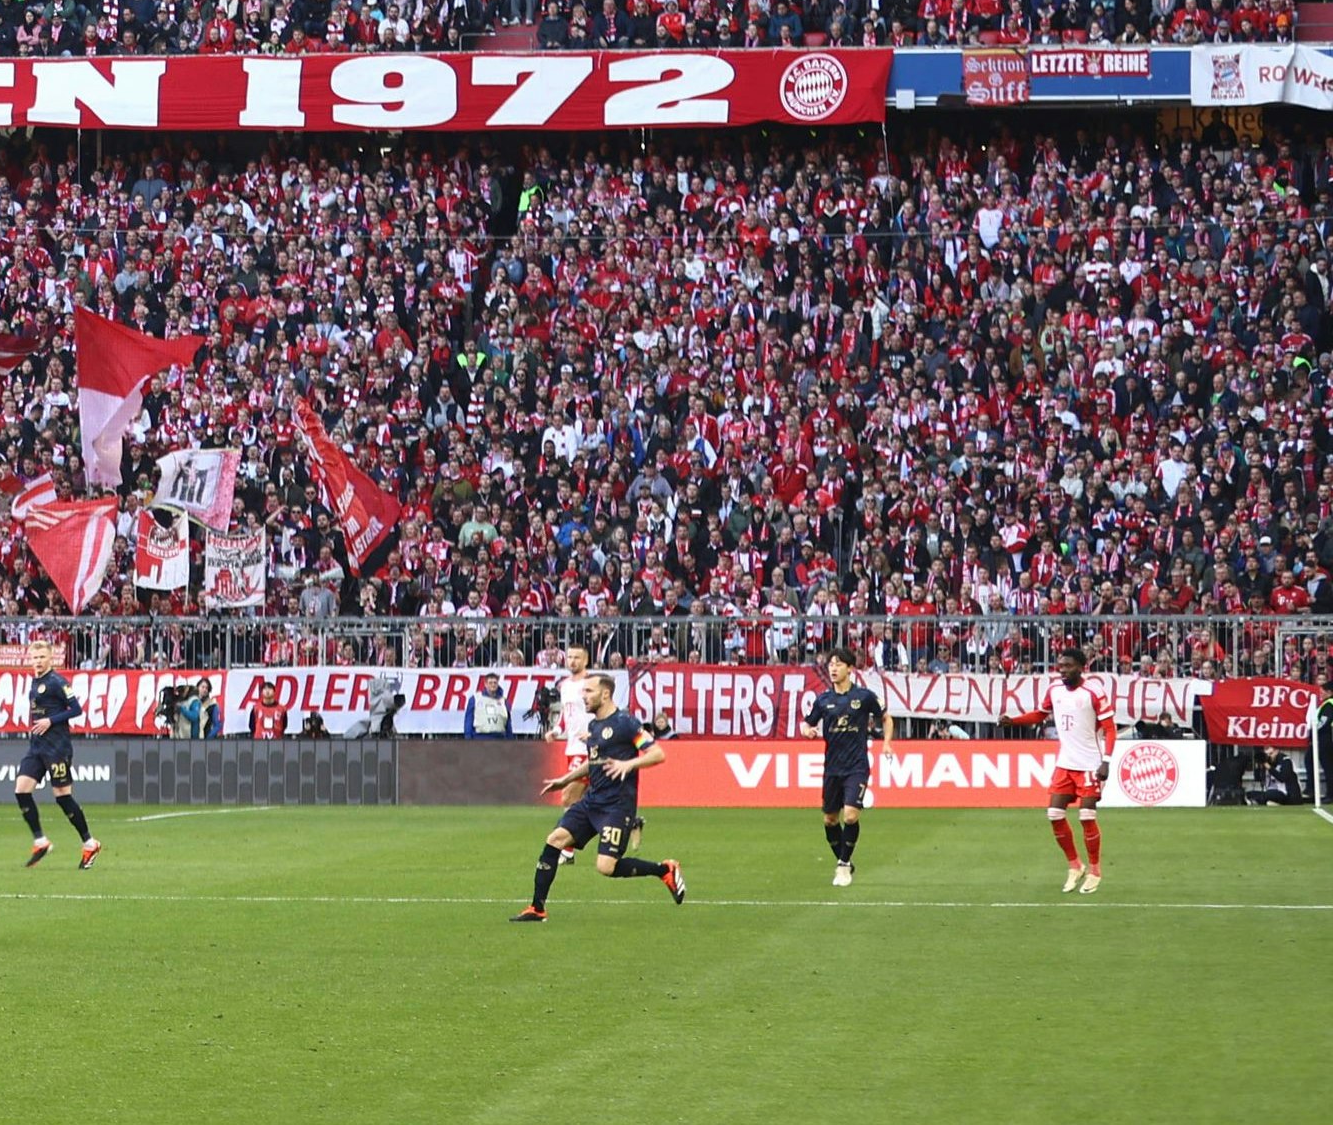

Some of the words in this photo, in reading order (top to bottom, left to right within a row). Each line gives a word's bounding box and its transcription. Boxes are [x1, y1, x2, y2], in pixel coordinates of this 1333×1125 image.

[965, 57, 1025, 73] Sektion
[1031, 53, 1085, 74] LETZTE
[1103, 52, 1149, 73] REIHE
[237, 53, 737, 127] 1972
[636, 671, 775, 737] SELTERS
[1251, 685, 1310, 708] BFC
[1136, 745, 1174, 770] BAYERN
[51, 763, 67, 778] 29
[600, 825, 622, 846] 30
